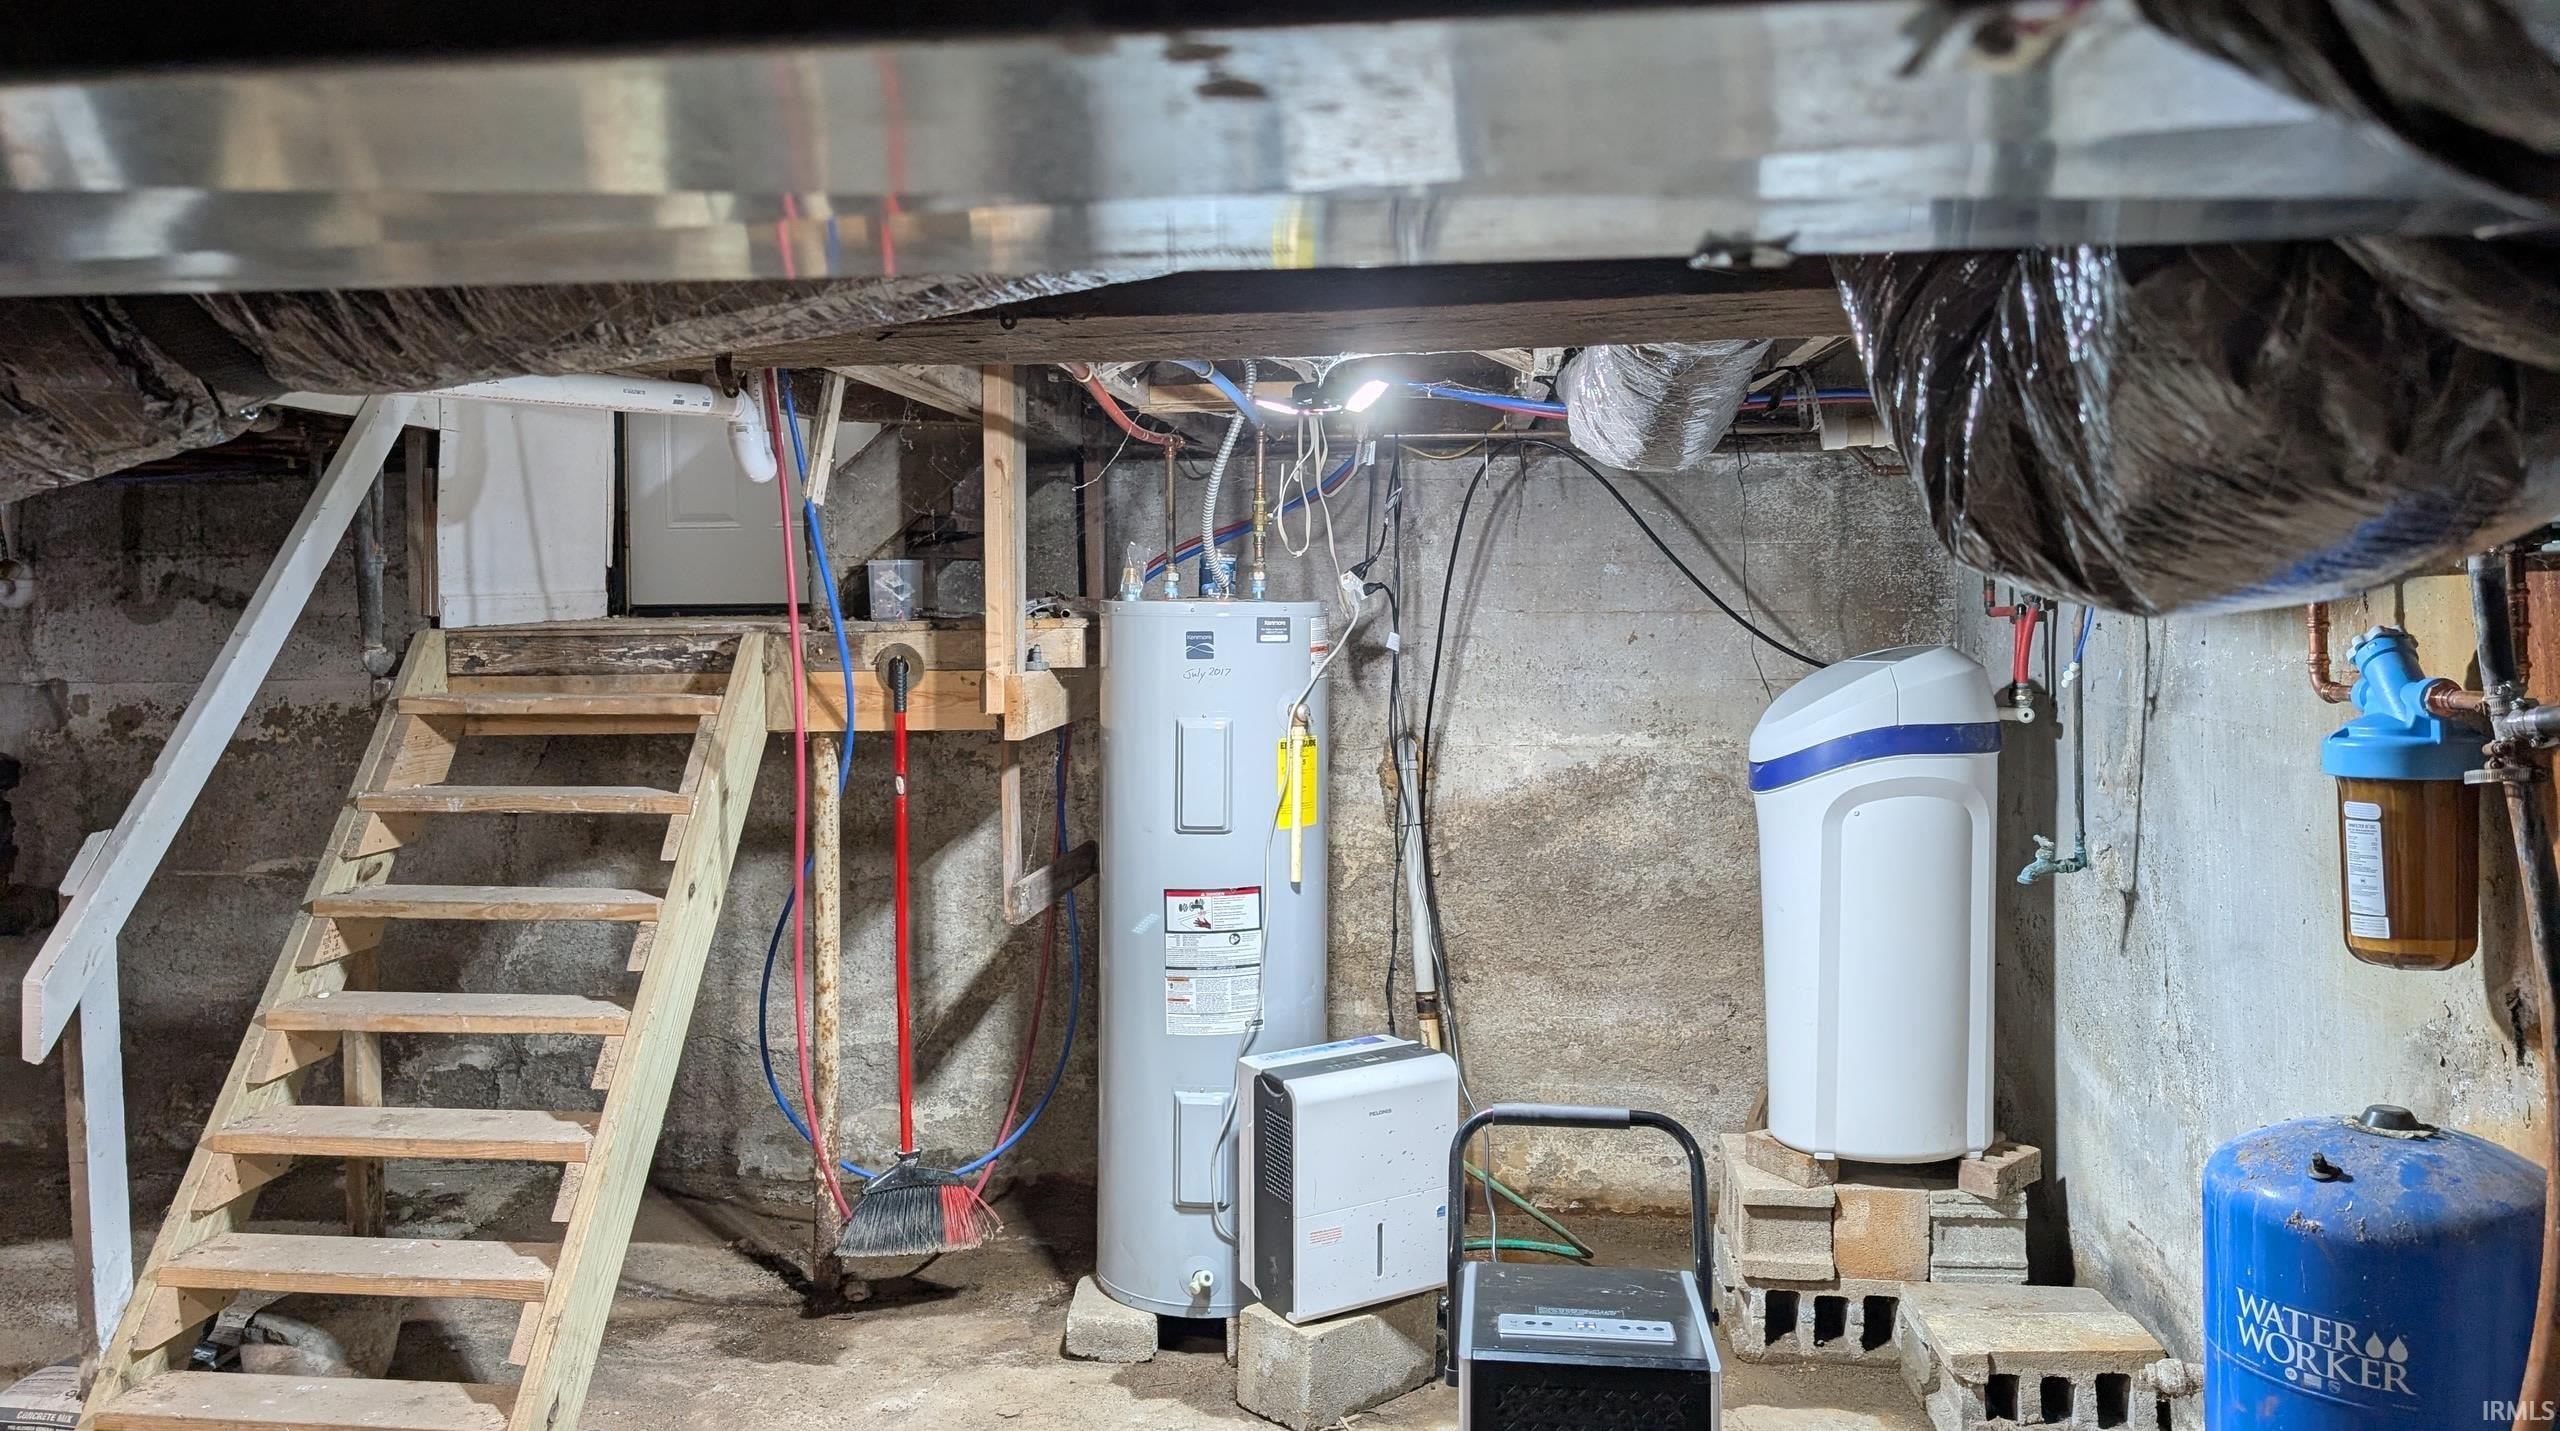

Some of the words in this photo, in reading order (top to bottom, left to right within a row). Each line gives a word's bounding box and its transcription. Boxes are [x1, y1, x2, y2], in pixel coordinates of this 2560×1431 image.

[1183, 667, 1206, 683] July
[1208, 667, 1231, 677] 2017
[1369, 1108, 1392, 1116] PELONIS
[2236, 1287, 2369, 1357] WATER
[2236, 1316, 2416, 1395] WORKER
[16, 1411, 57, 1421] CONCRETE
[56, 1413, 73, 1423] MIX
